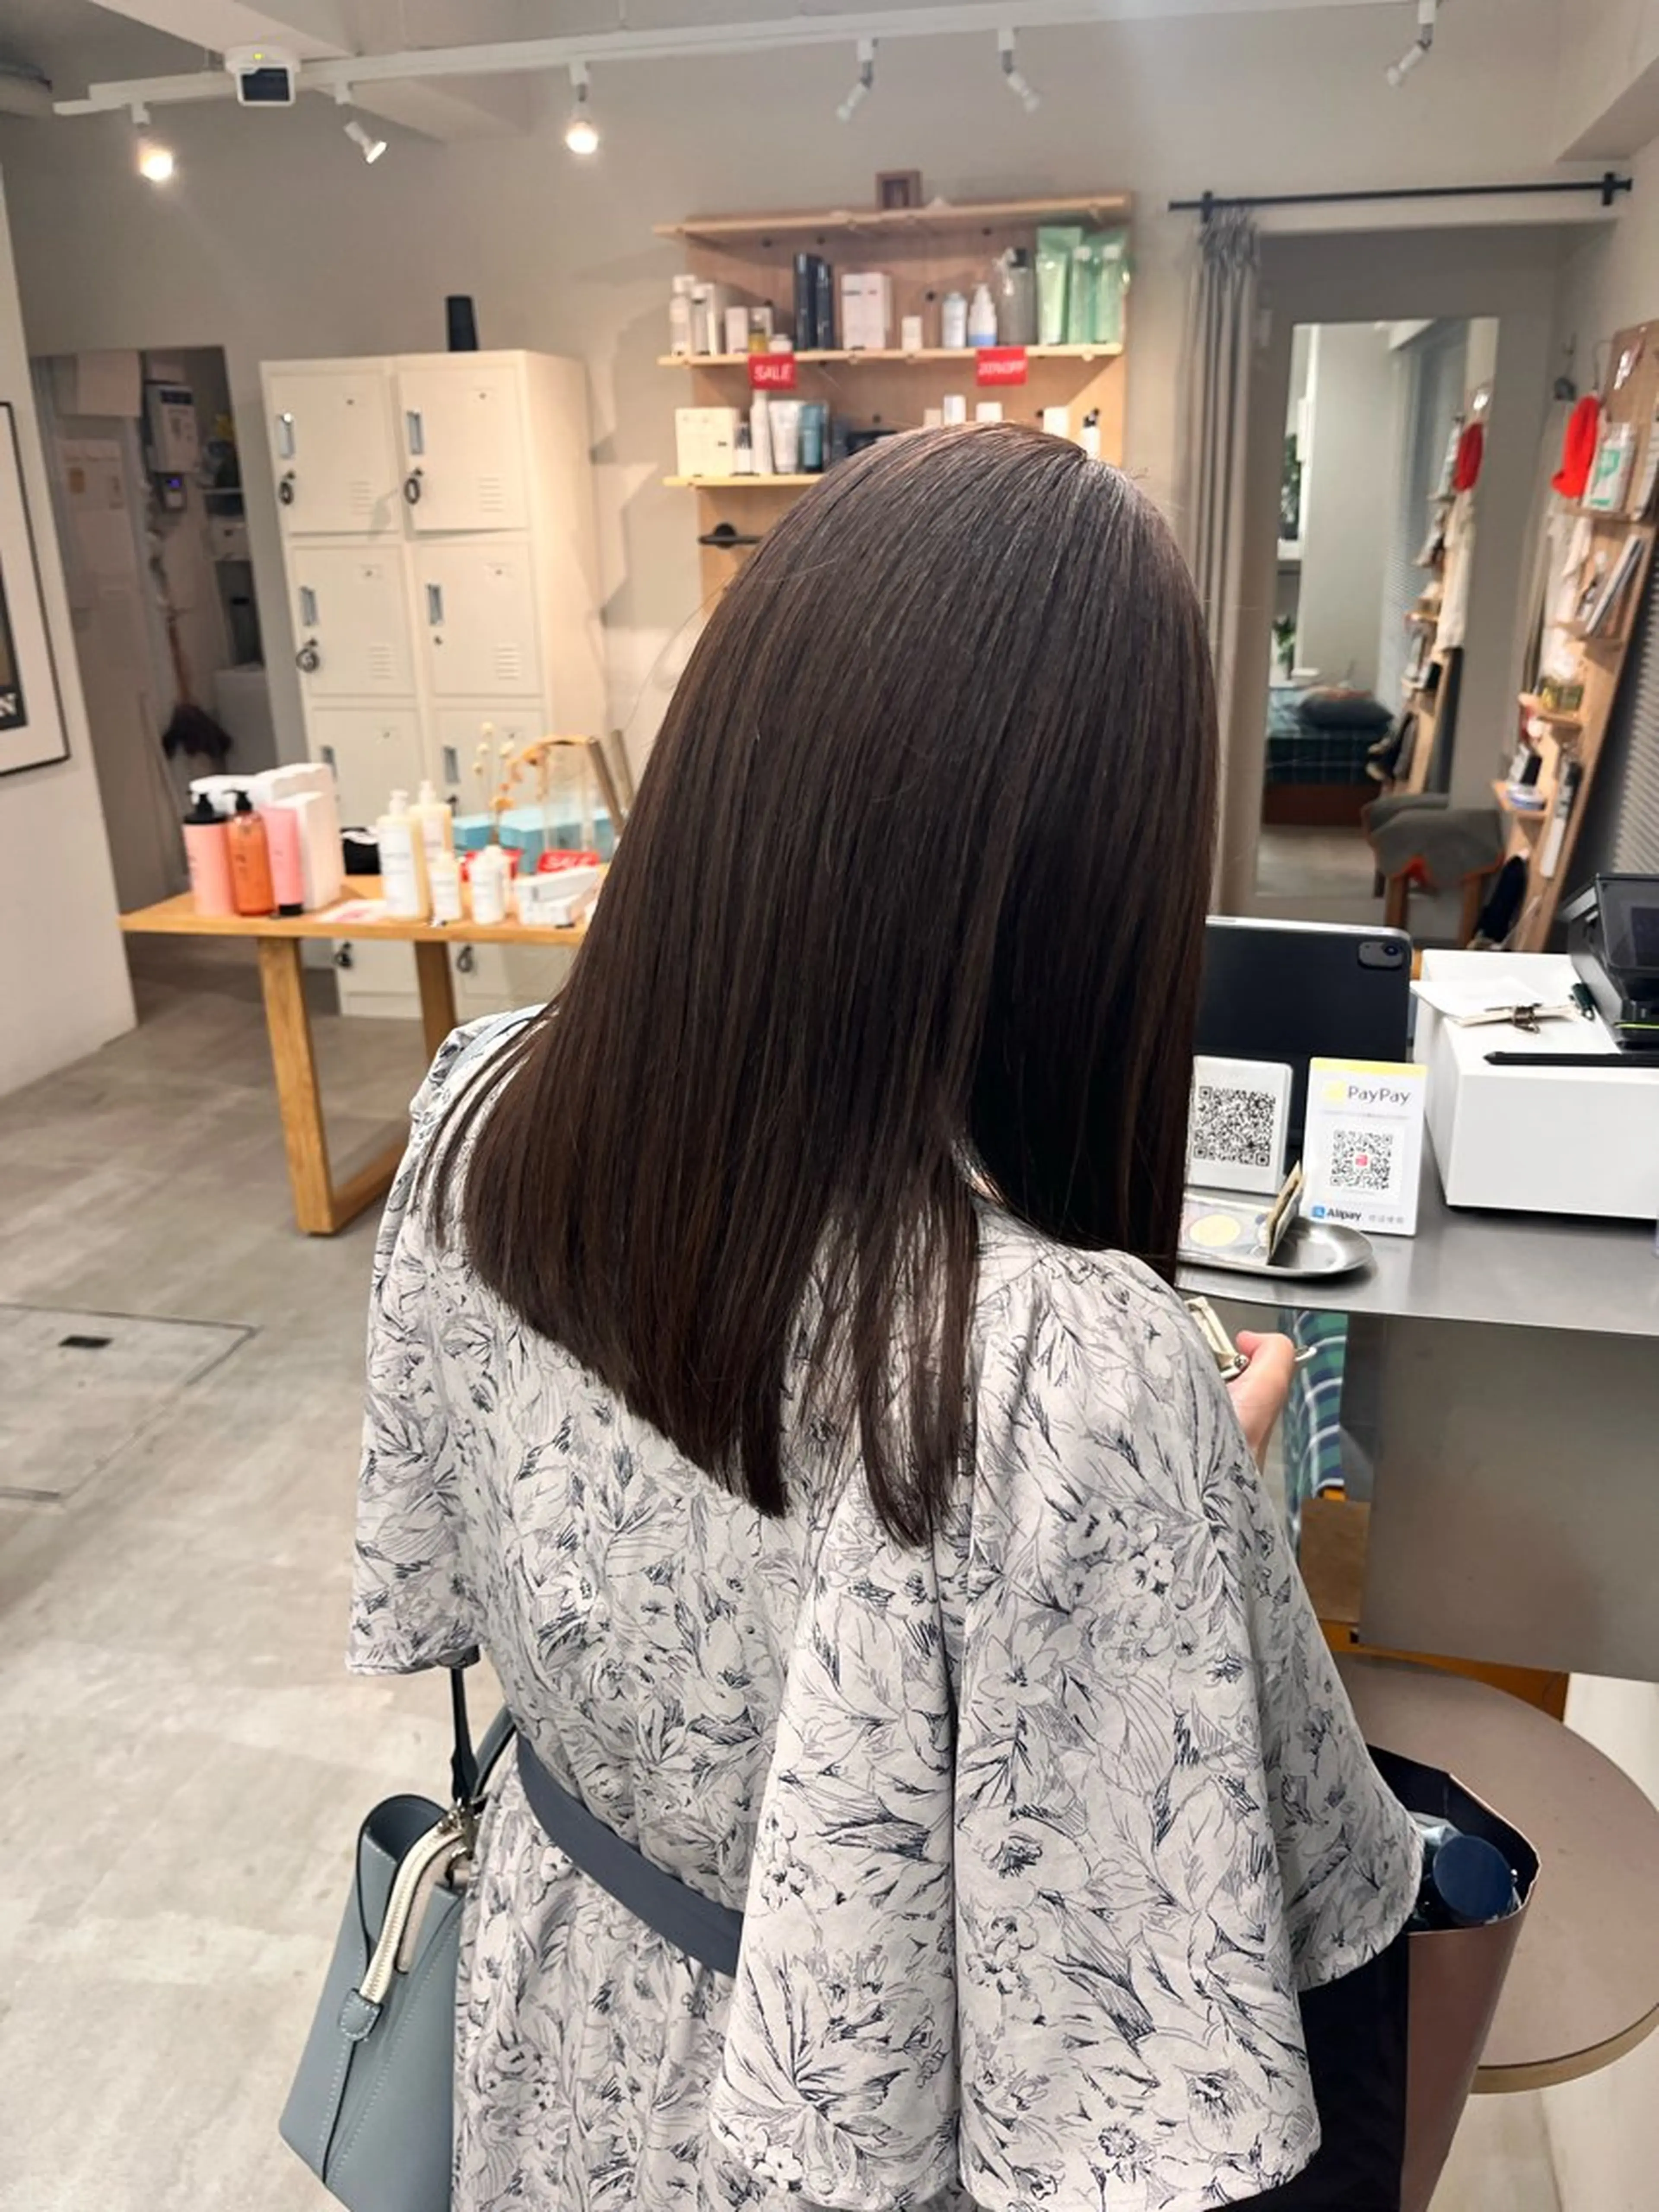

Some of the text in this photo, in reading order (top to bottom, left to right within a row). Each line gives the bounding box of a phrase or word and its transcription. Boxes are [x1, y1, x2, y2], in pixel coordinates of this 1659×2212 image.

[754, 363, 793, 381] SALE
[1348, 1085, 1411, 1107] PayPay
[1327, 1208, 1361, 1221] Alipay
